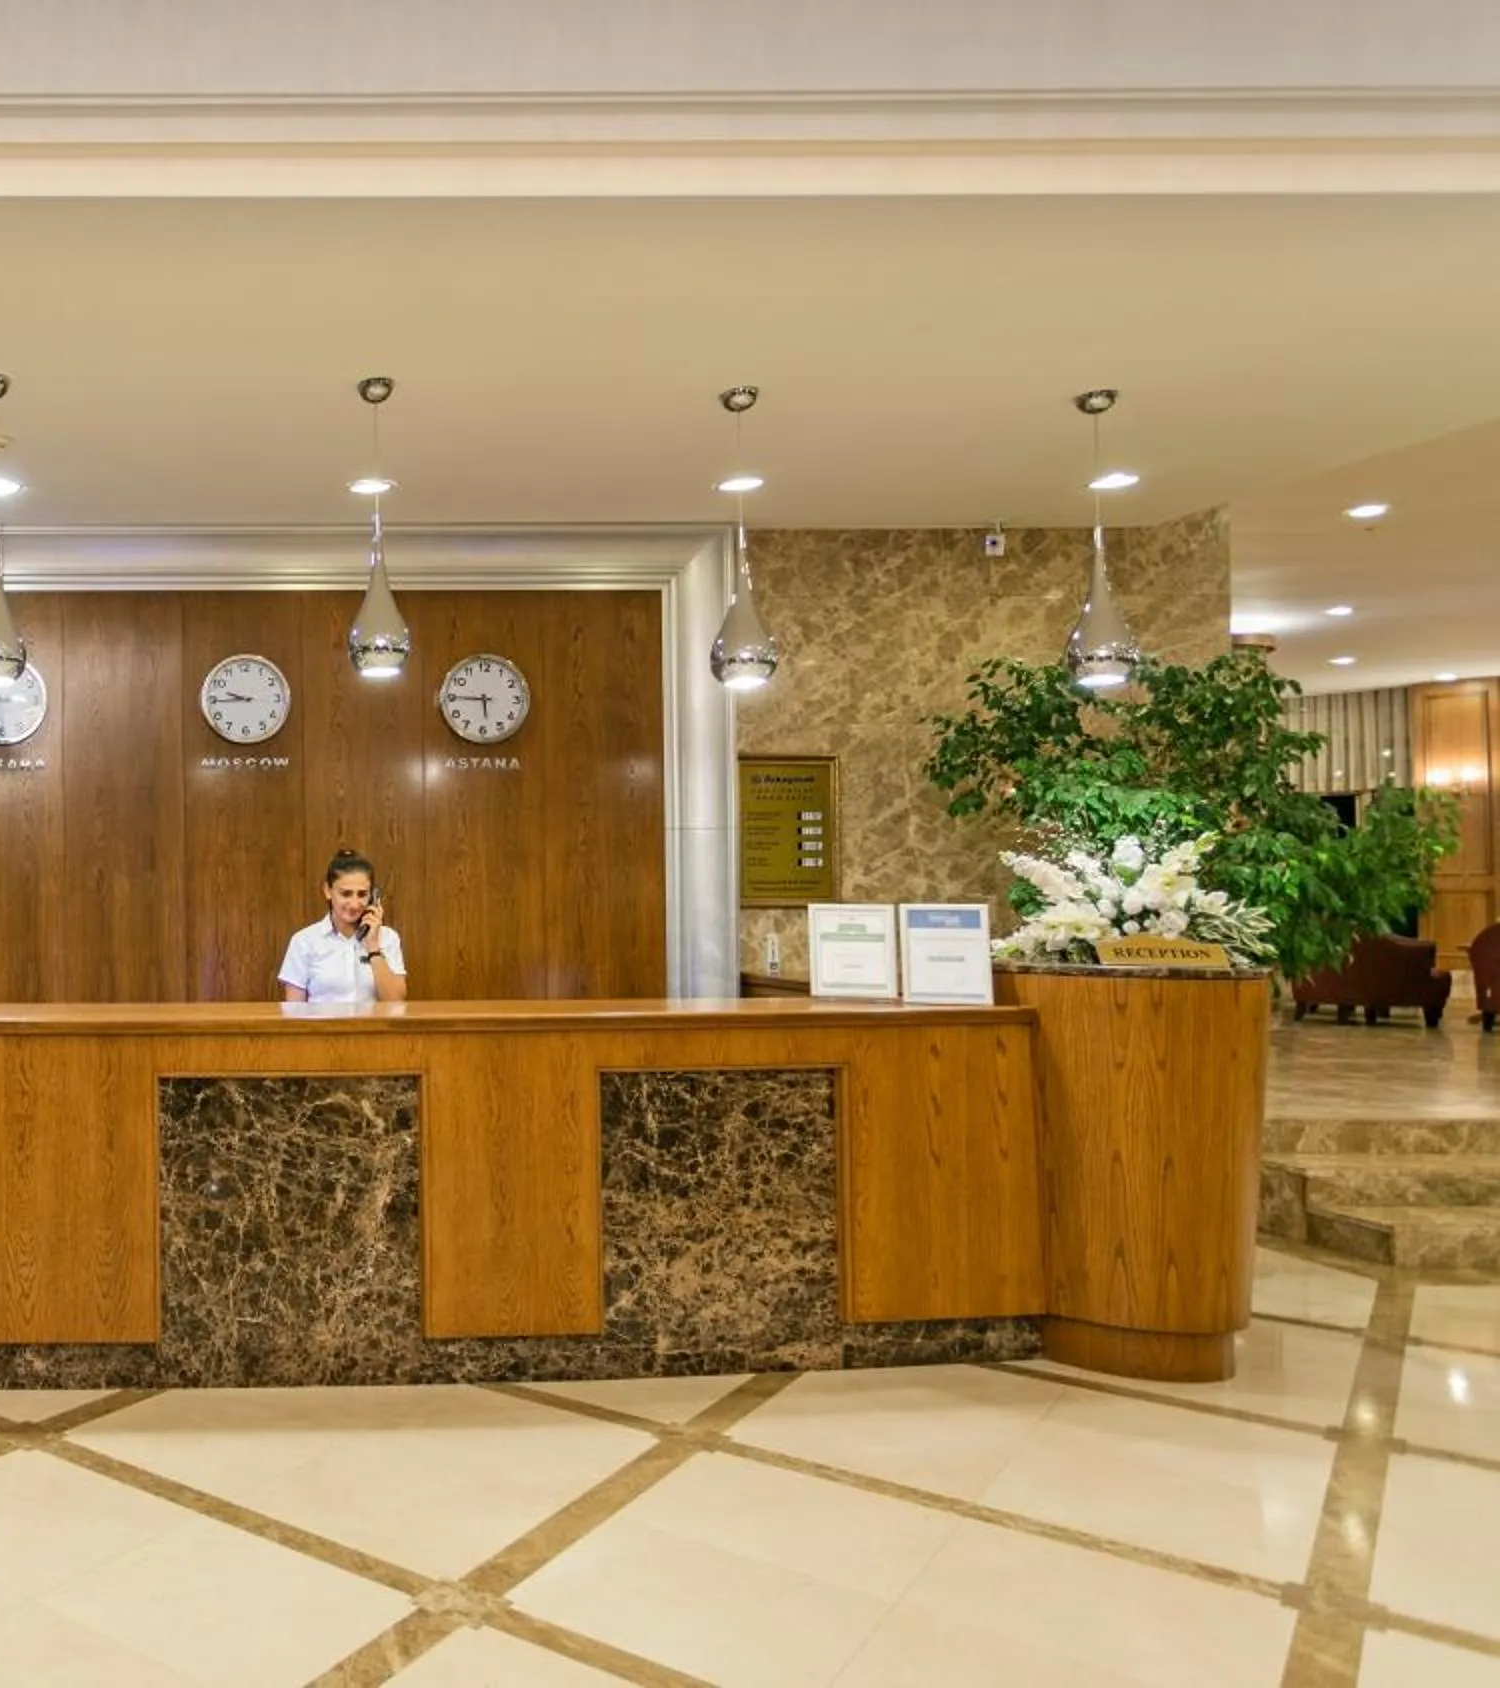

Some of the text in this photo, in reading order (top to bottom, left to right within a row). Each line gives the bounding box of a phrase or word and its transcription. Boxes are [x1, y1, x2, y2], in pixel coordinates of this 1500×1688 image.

[201, 757, 289, 770] MOSCOW
[445, 757, 521, 769] ASTANA
[1113, 947, 1212, 959] RECEPTION
